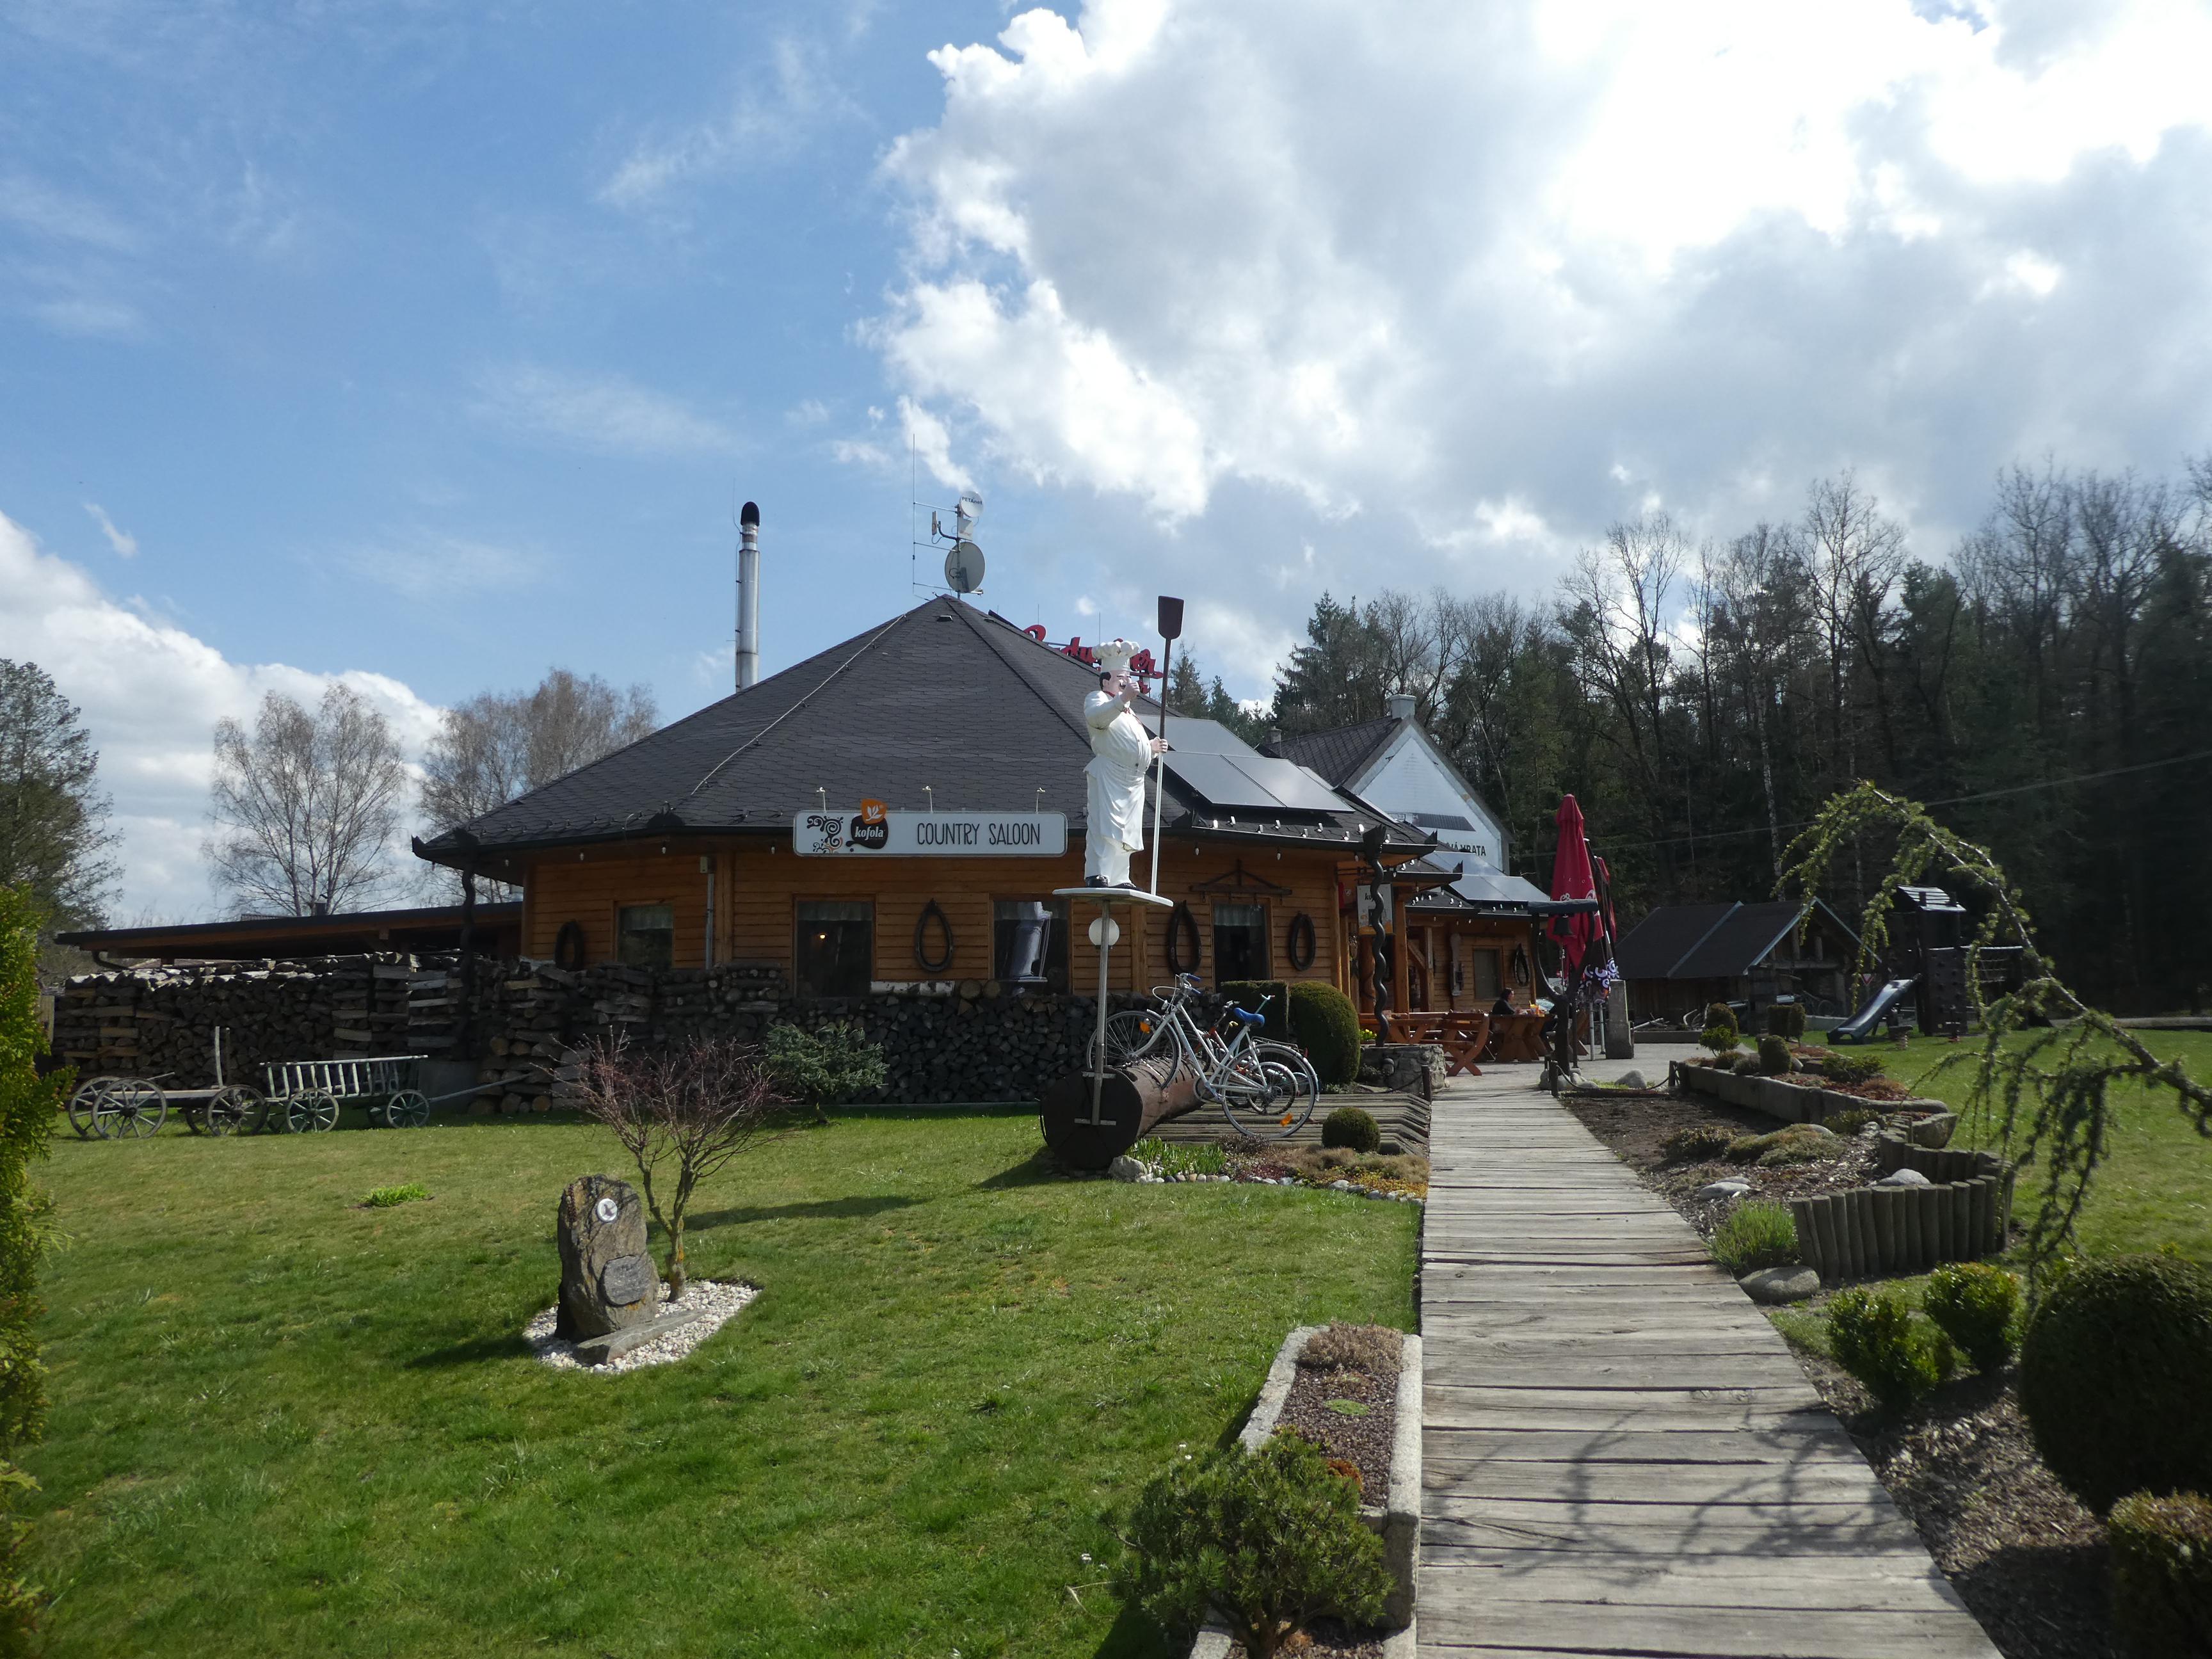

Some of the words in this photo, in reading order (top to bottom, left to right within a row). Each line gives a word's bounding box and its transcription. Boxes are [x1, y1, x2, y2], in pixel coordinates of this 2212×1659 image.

[854, 826, 884, 841] kofola
[917, 822, 980, 846] COUNTRY
[989, 823, 1040, 846] SALOON
